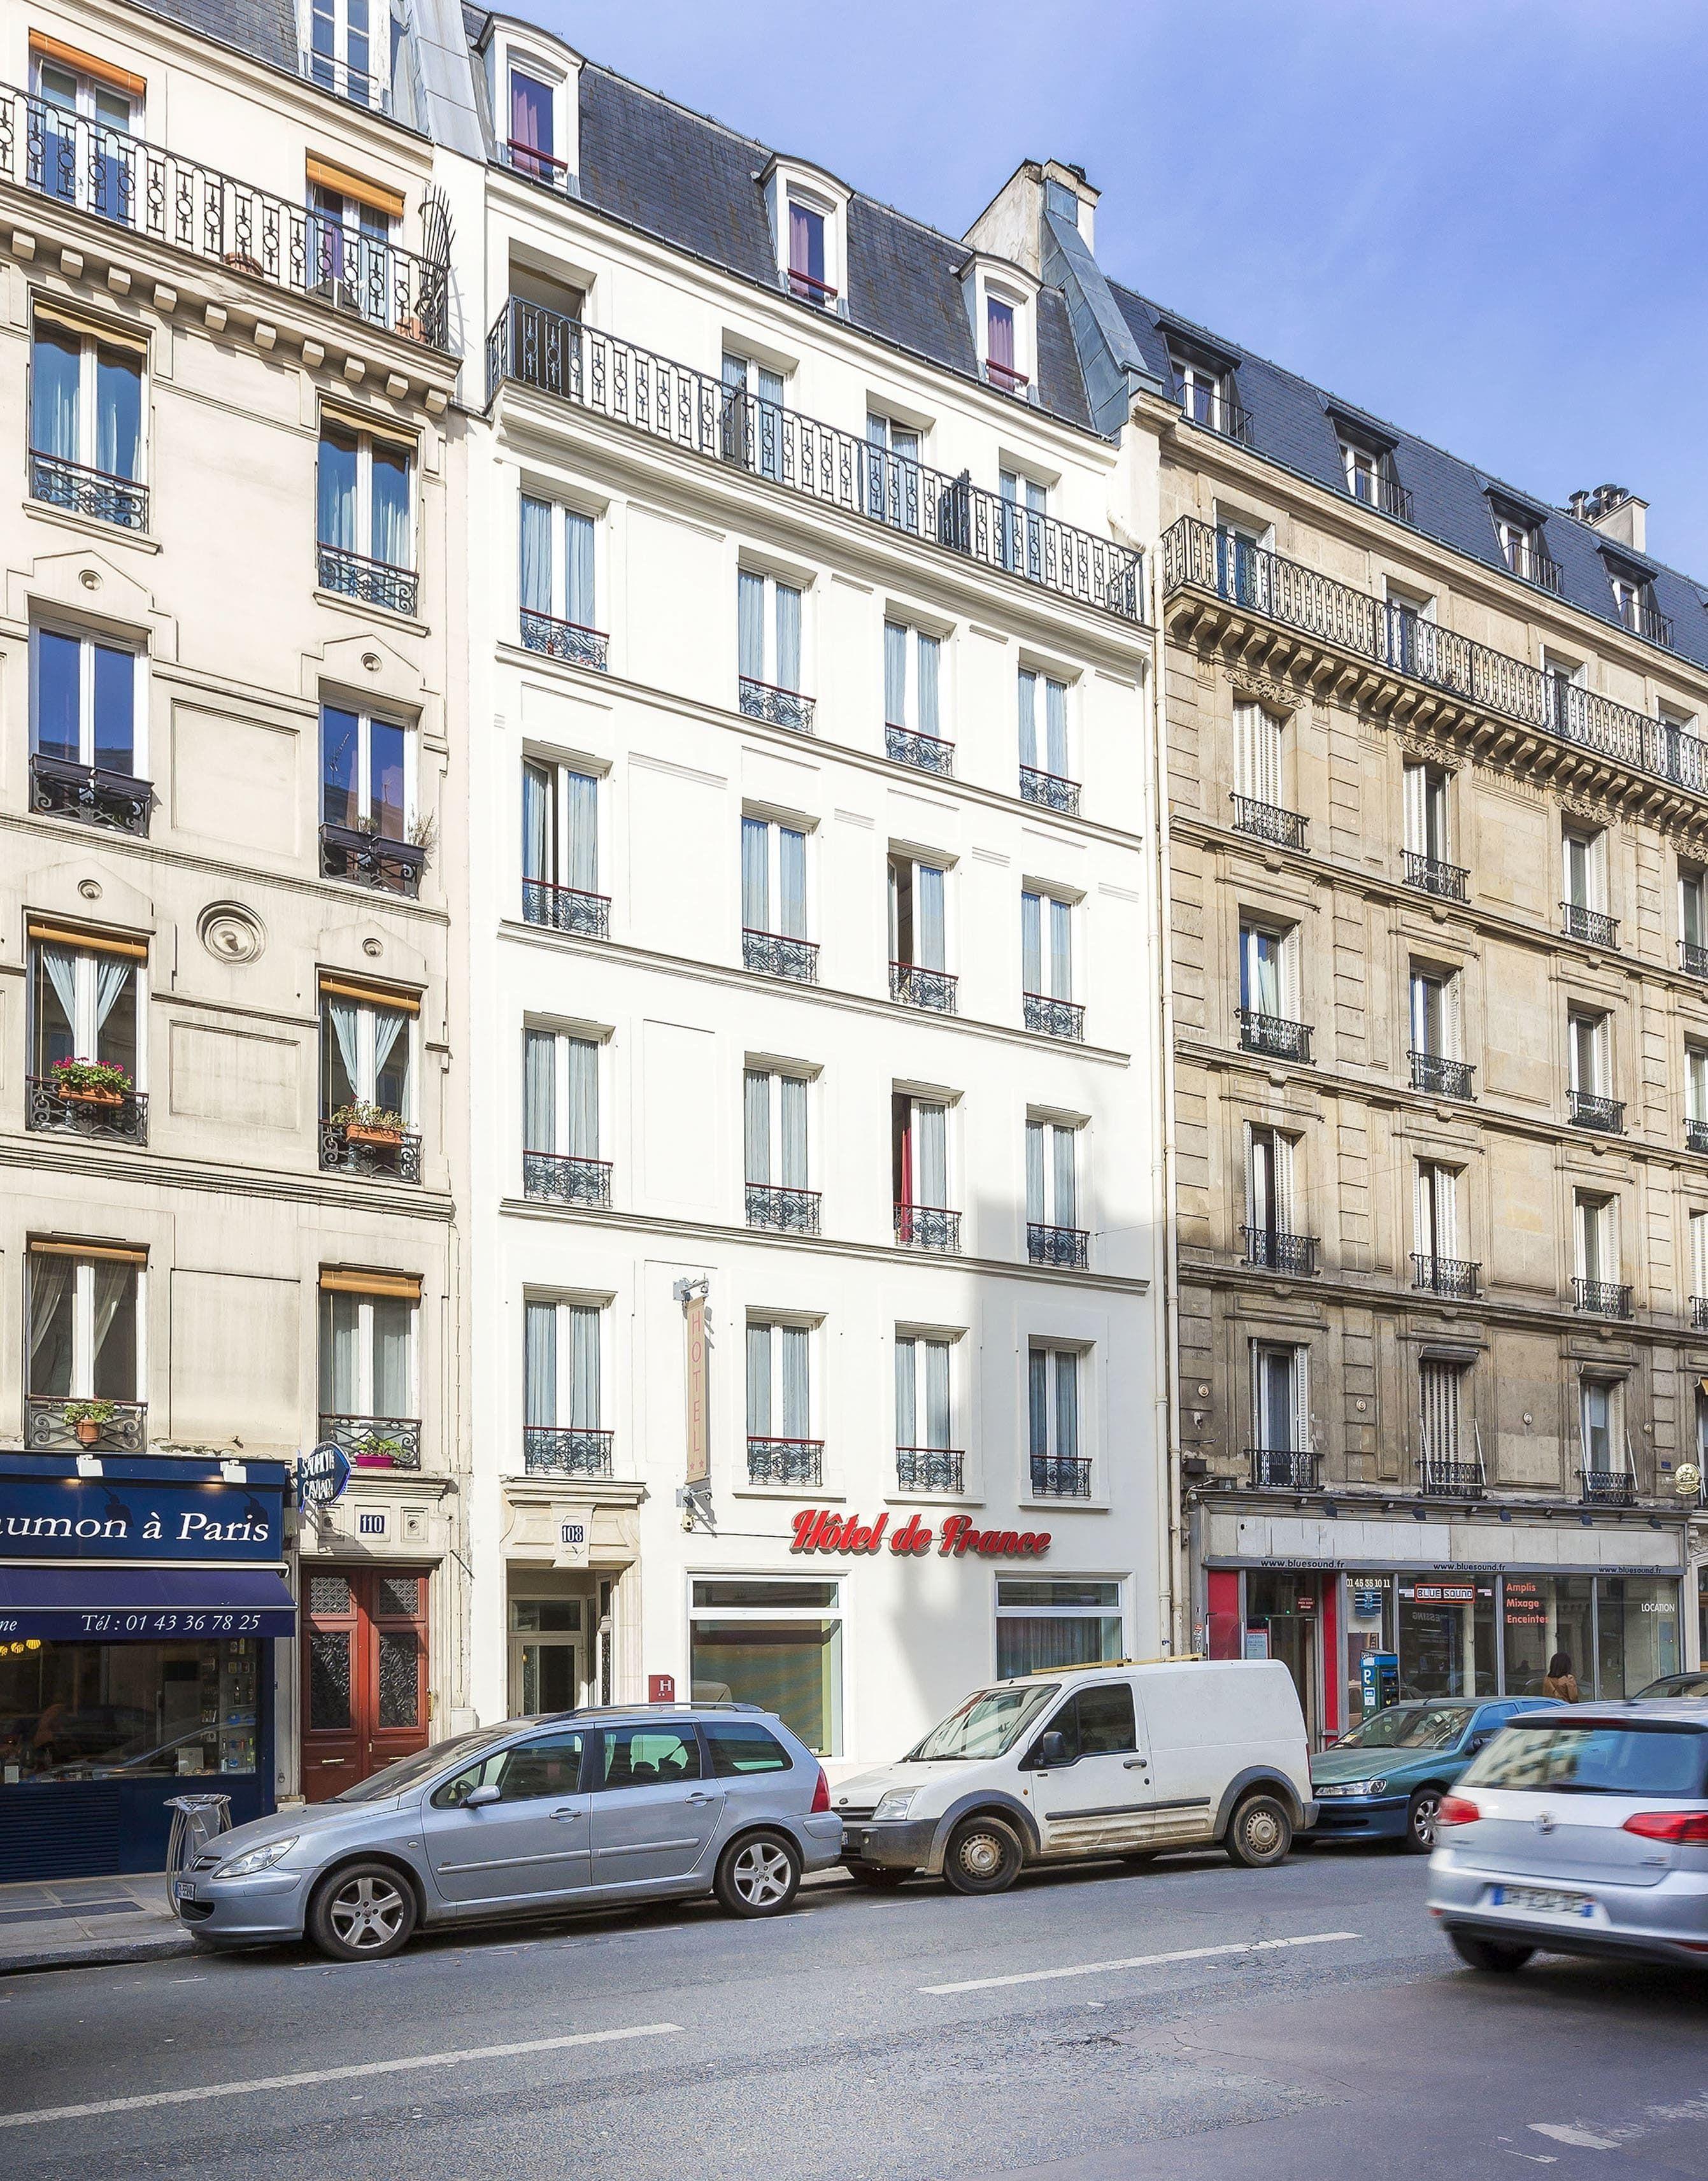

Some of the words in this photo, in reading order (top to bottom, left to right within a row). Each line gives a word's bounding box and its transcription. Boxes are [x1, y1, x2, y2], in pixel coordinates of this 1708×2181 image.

[692, 1310, 701, 1453] HOTEL
[0, 1516, 128, 1538] umon
[142, 1511, 163, 1540] à
[175, 1512, 269, 1542] Paris
[362, 1516, 382, 1532] 110
[562, 1526, 582, 1542] 108
[792, 1509, 890, 1551] Hôtel
[892, 1513, 932, 1551] de
[940, 1514, 1053, 1554] France
[1260, 1559, 1345, 1568] www.bluesound.fr
[1433, 1562, 1506, 1572] www.bluesound.fr
[1598, 1565, 1662, 1575] www.bluesound.fr
[1346, 1578, 1354, 1588] 01
[1375, 1579, 1382, 1588] 10
[1383, 1579, 1391, 1588] 11
[1506, 1582, 1536, 1593] Amplis
[1418, 1589, 1441, 1598] BLUE
[1444, 1589, 1473, 1598] SOUND
[1506, 1598, 1539, 1610] Mixage
[1641, 1603, 1675, 1613] LOCATION
[126, 1615, 147, 1631] 01
[153, 1615, 177, 1631] 43
[183, 1615, 206, 1630] 36
[212, 1615, 233, 1630] 78
[238, 1614, 260, 1630] 25
[660, 1680, 672, 1692] H
